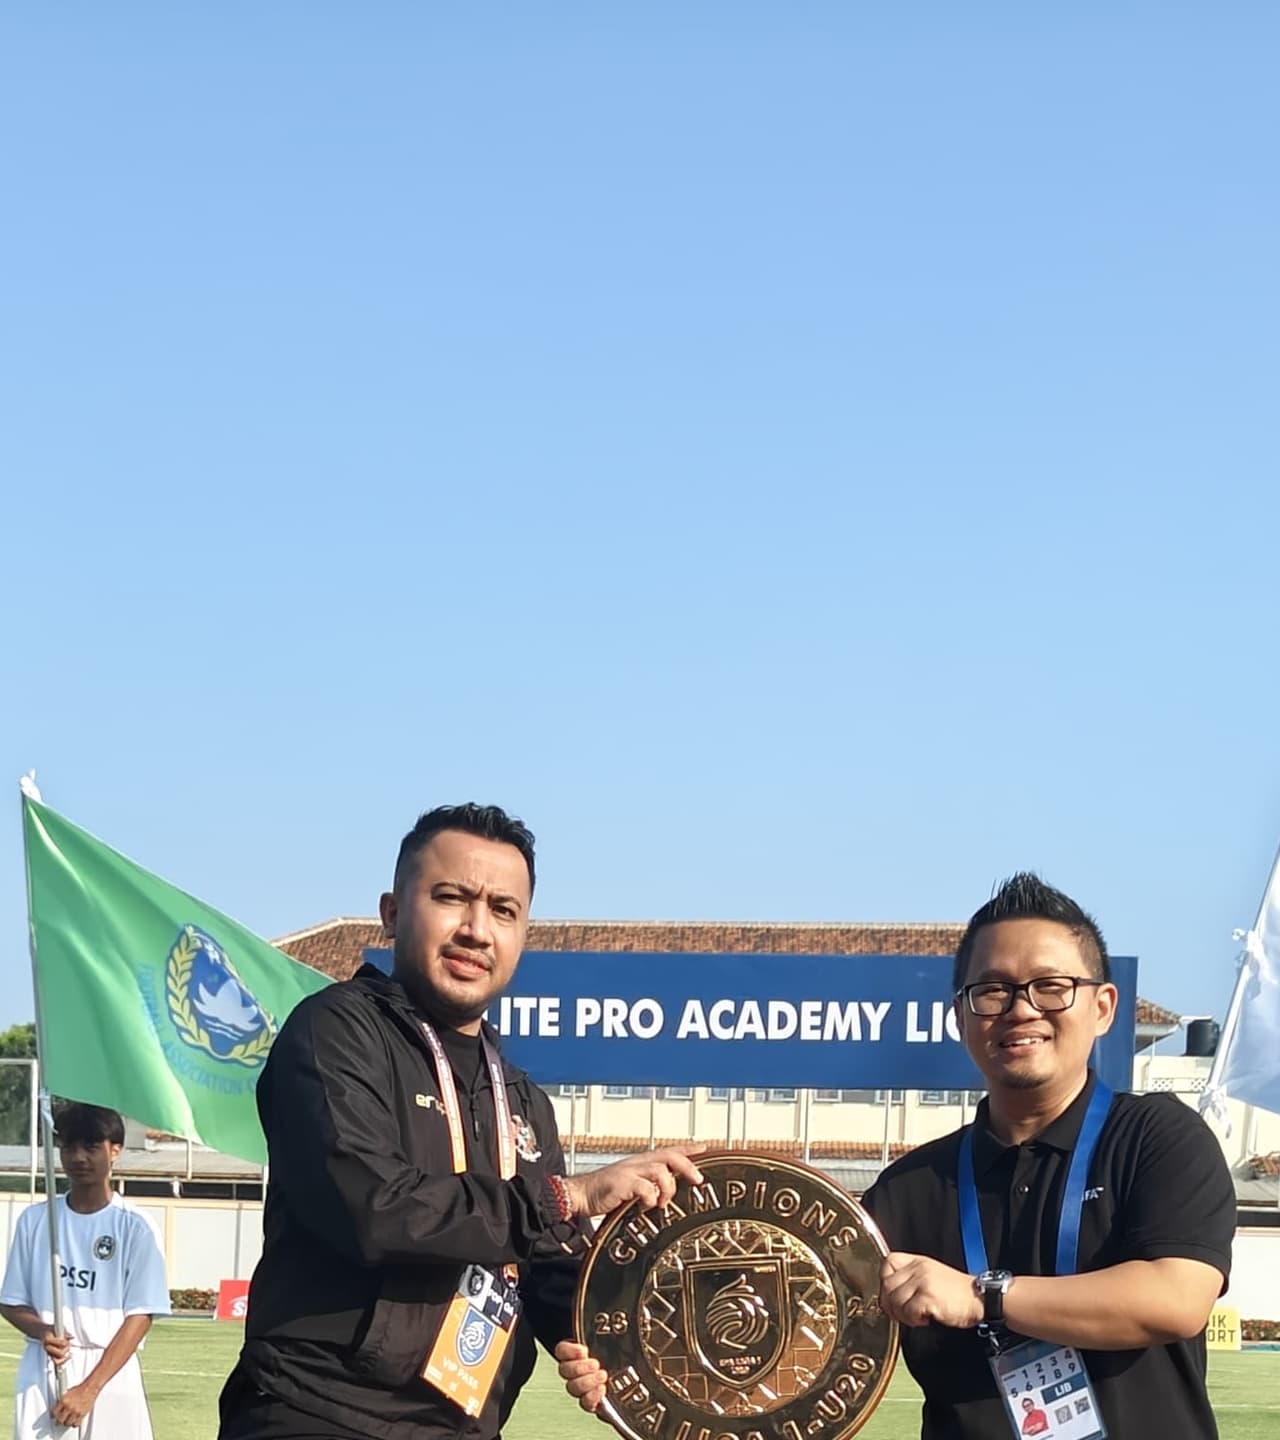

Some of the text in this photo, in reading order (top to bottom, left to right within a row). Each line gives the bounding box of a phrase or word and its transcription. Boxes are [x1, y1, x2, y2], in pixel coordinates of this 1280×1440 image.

[481, 996, 560, 1036] ITE
[575, 998, 664, 1039] PRO
[676, 999, 892, 1041] ACADEMY
[608, 1181, 859, 1265] CHAMPIONS
[594, 1311, 629, 1335] 23
[1010, 1362, 1076, 1398] 5 6 7 8 9
[1021, 1369, 1028, 1379] 1
[1035, 1363, 1043, 1373] 2
[1050, 1356, 1058, 1366] 3
[608, 1365, 667, 1434] EPA
[1054, 1382, 1073, 1397] LIB
